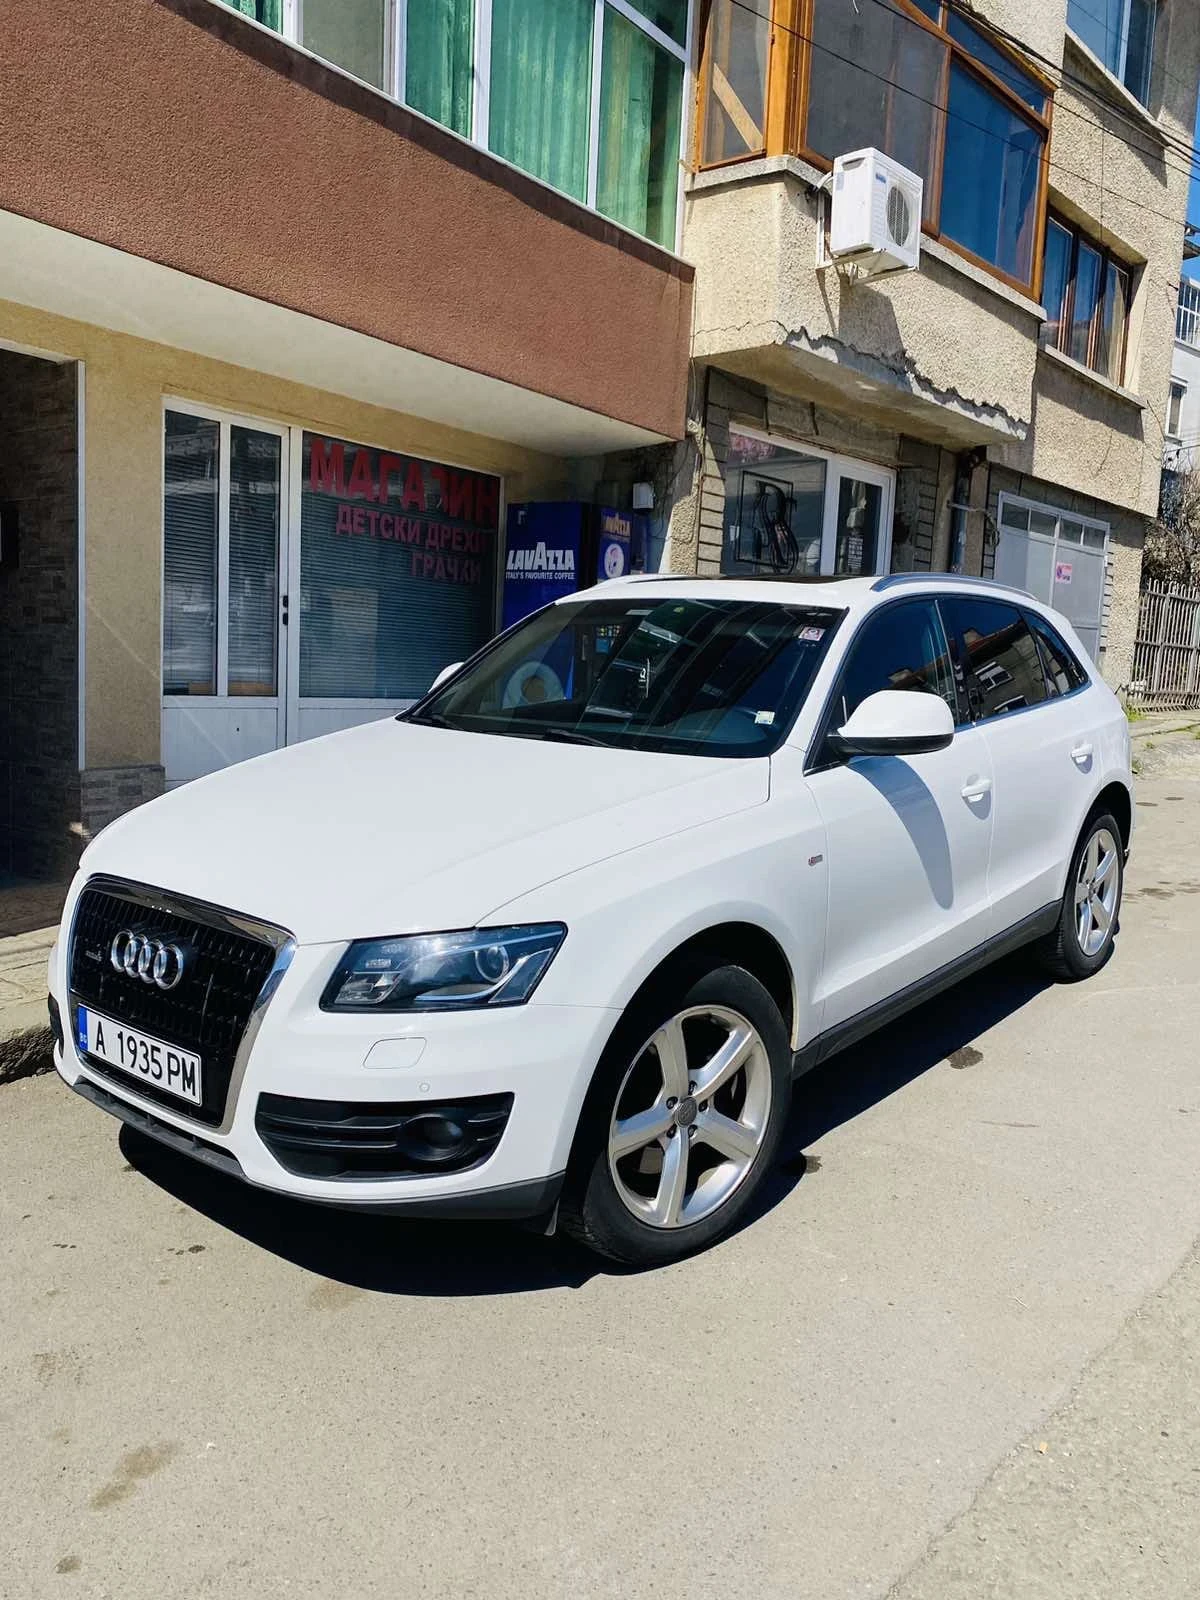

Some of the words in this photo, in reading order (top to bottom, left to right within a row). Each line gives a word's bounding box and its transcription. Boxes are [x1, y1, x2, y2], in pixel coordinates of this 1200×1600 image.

[310, 438, 498, 527] МАГАЗИН
[336, 504, 420, 544] ДЕТСКИ
[410, 552, 481, 584] ГРАЧКИ
[506, 542, 575, 571] LAVAZZA
[505, 571, 524, 580] ITALY'S
[525, 571, 553, 580] FAVOURITE
[554, 572, 576, 580] COFFEE
[96, 1021, 106, 1055] A
[117, 1031, 163, 1080] 1935
[167, 1052, 196, 1097] PM
